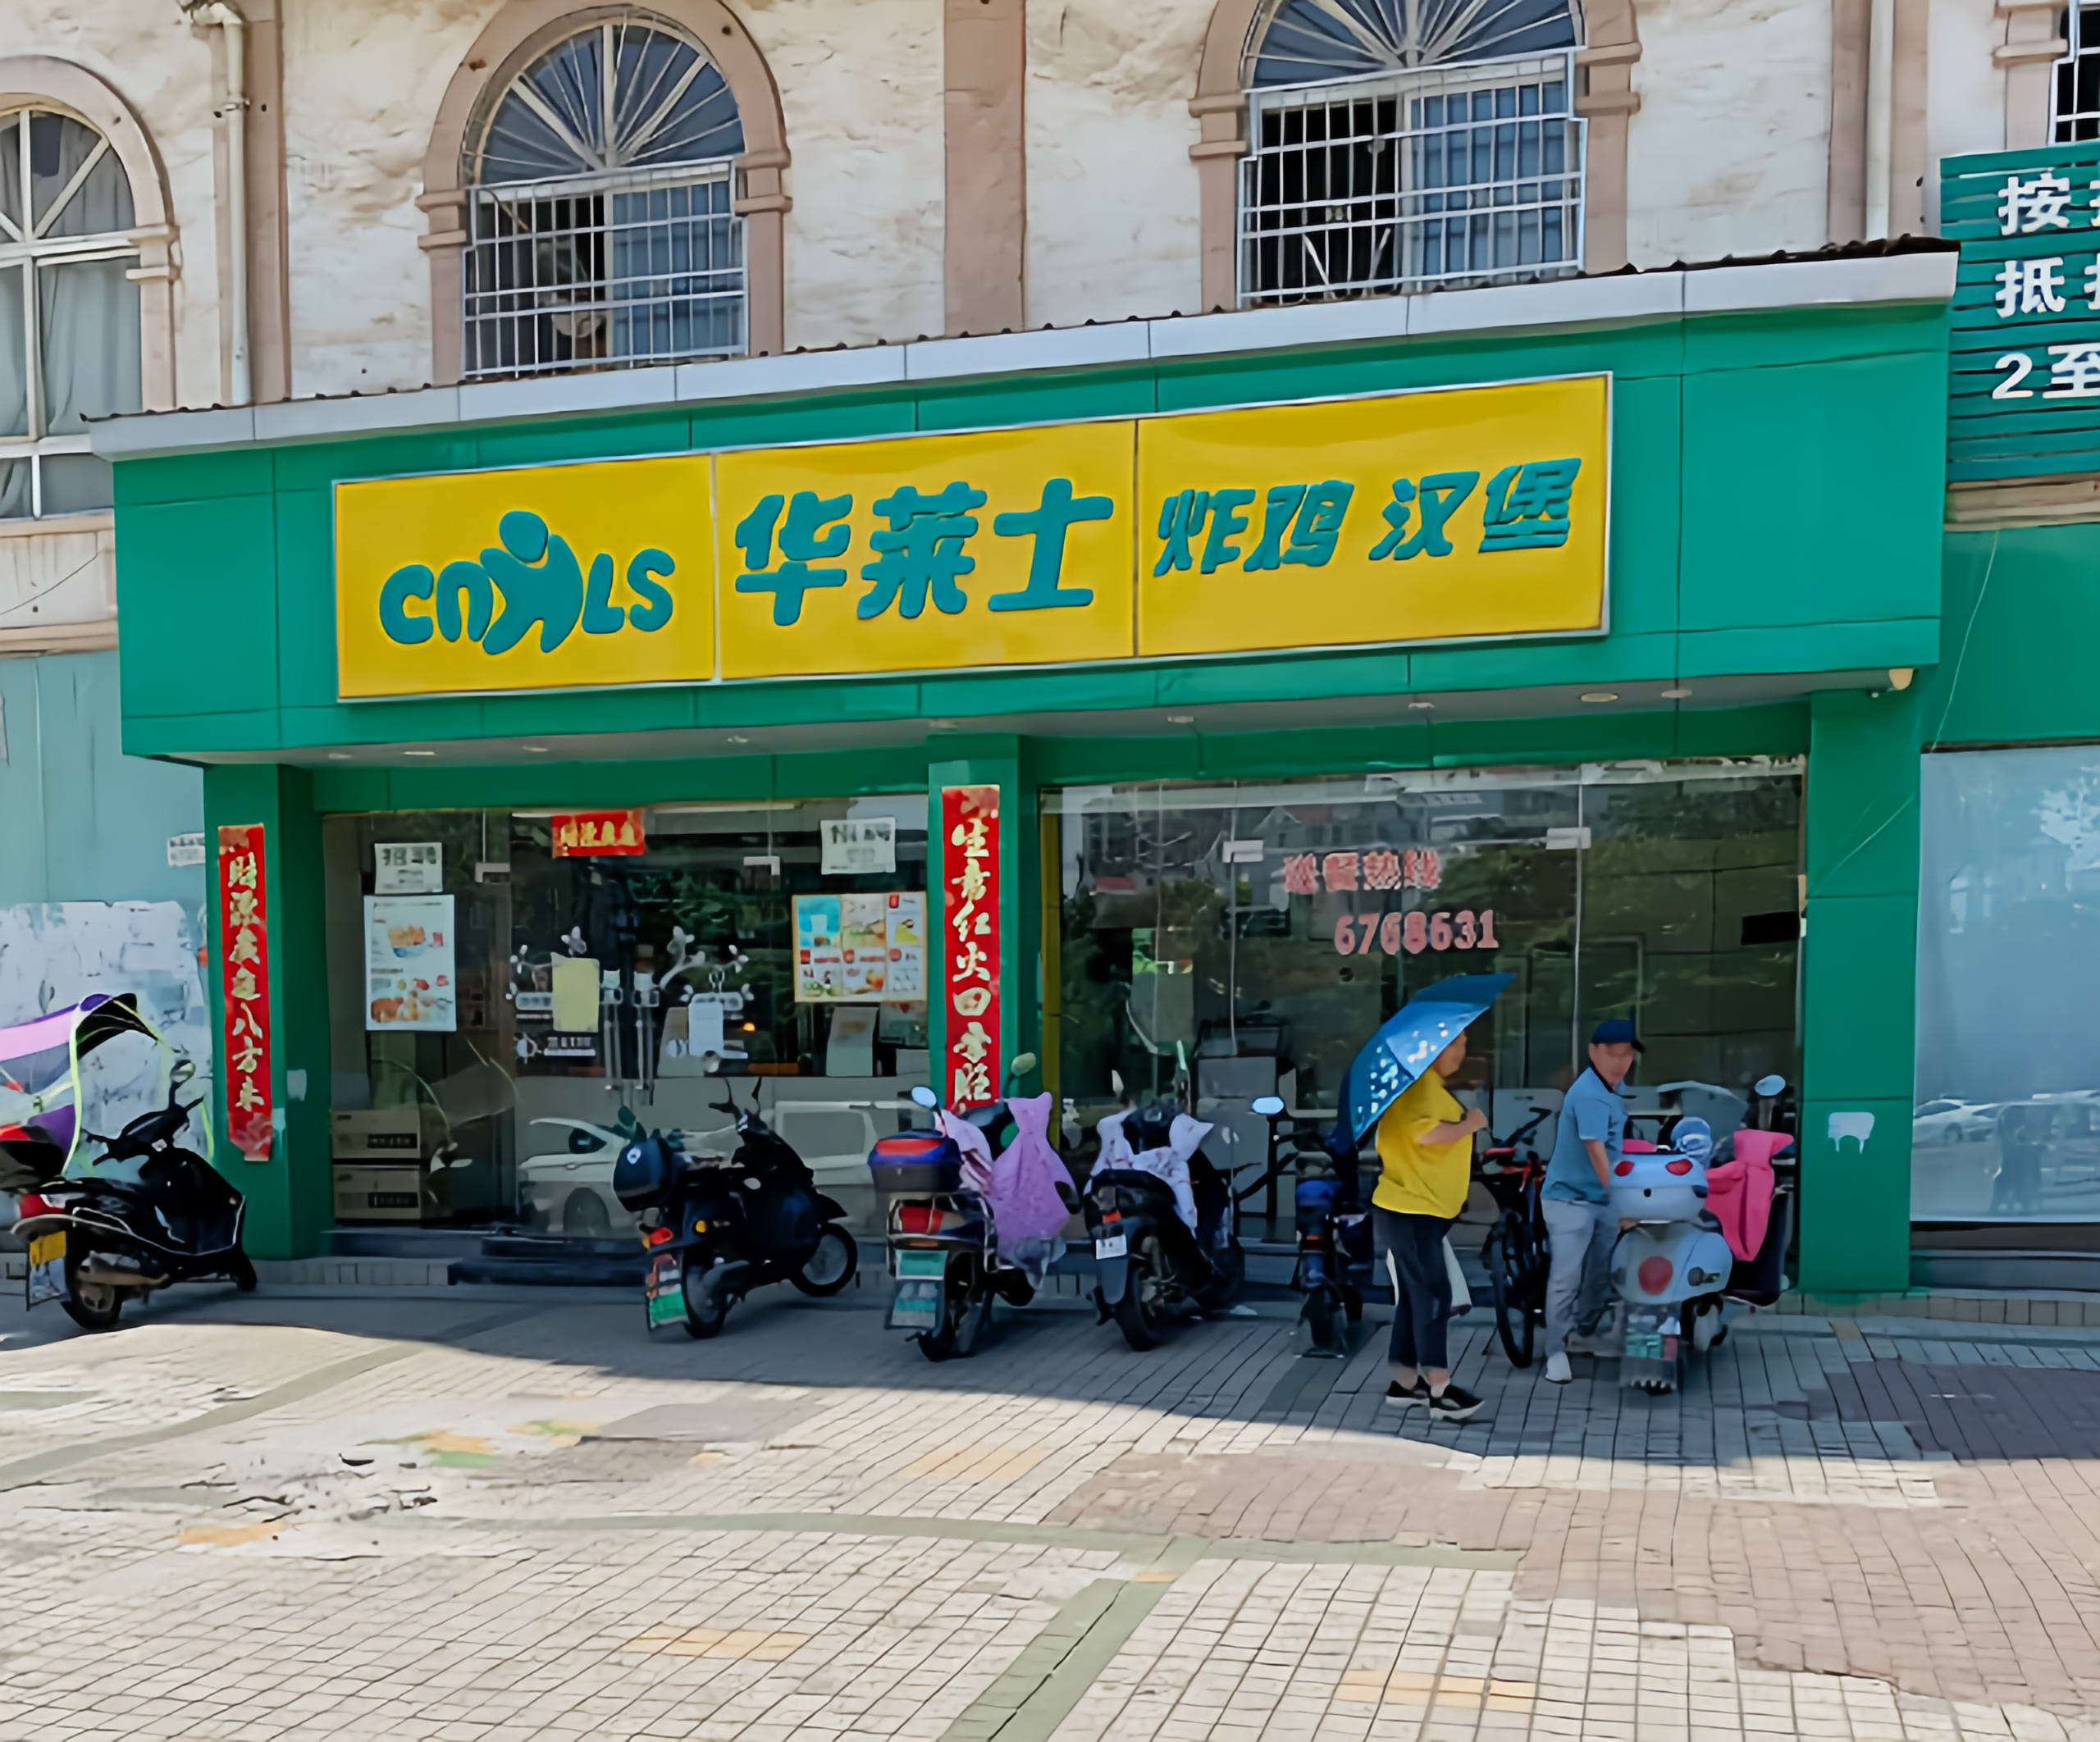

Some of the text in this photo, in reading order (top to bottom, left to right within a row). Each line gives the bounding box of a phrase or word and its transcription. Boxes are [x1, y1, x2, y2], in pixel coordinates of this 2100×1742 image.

[1997, 171, 2100, 236] 按
[1994, 253, 2100, 318] 抵
[1992, 341, 2100, 400] 2至
[735, 477, 1114, 627] 华莱士
